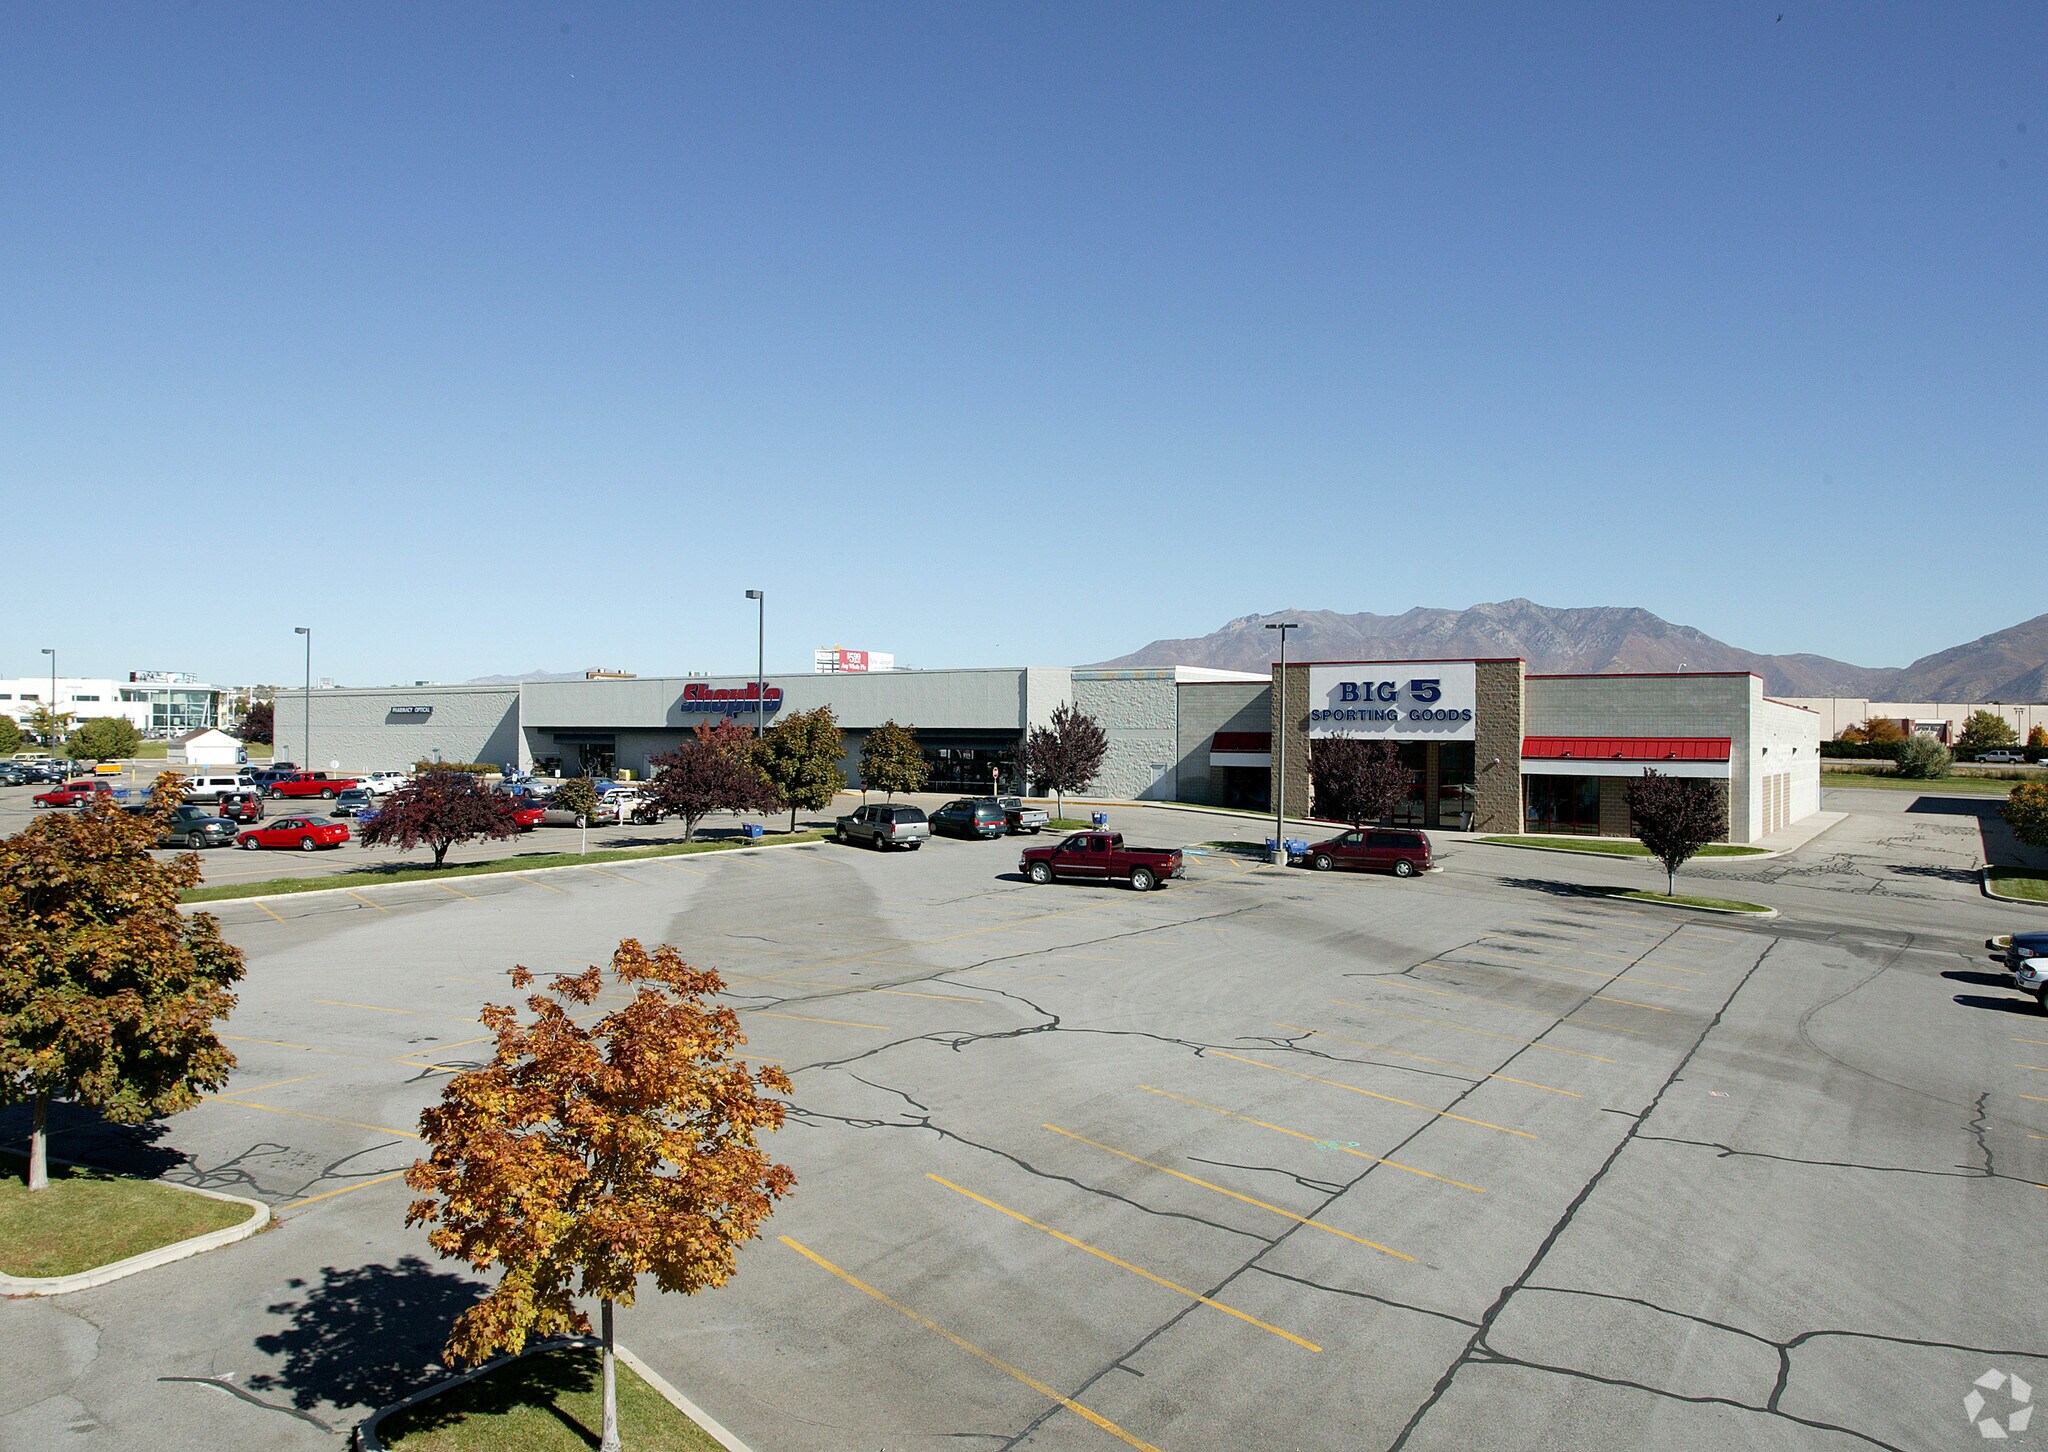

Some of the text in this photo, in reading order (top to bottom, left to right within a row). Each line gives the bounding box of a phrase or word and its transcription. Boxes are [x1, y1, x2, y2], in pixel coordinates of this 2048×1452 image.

[1340, 679, 1442, 703] BIG 5
[1311, 709, 1472, 721] SPORTING GOODS
